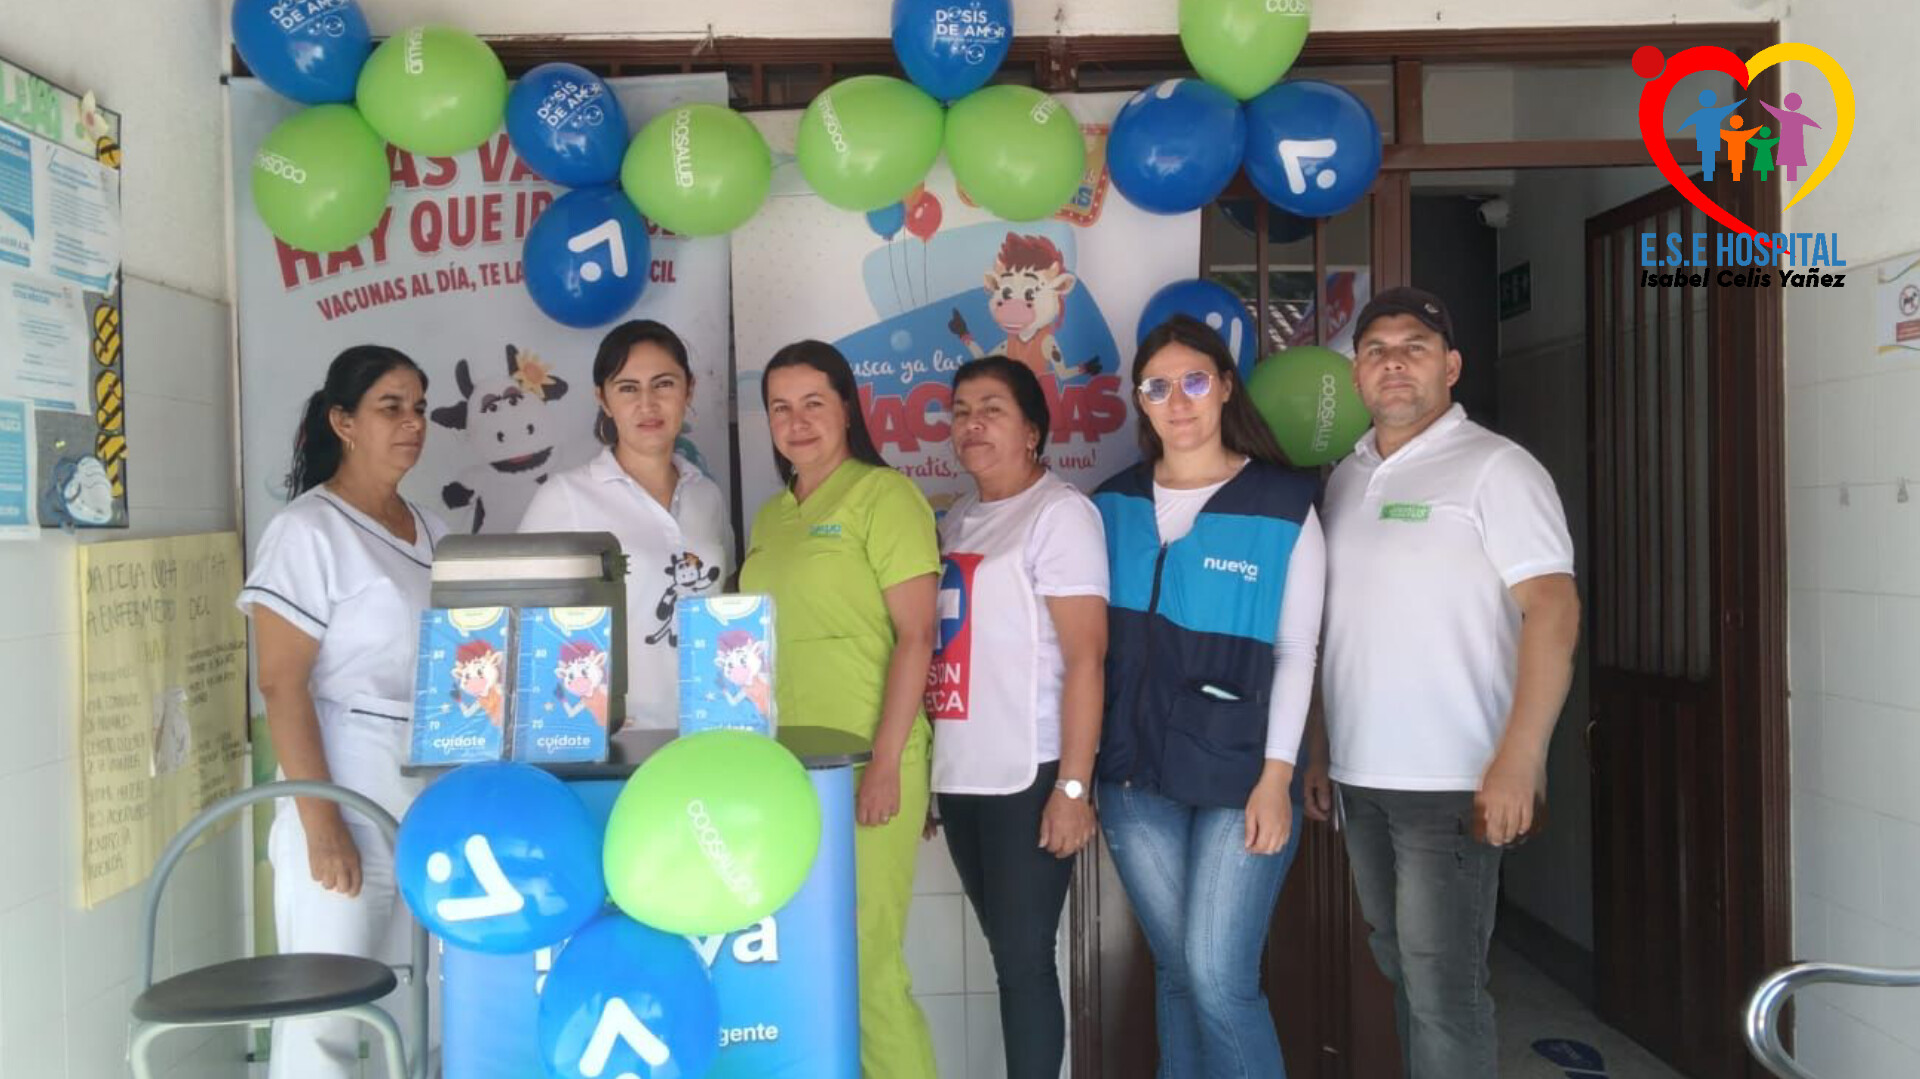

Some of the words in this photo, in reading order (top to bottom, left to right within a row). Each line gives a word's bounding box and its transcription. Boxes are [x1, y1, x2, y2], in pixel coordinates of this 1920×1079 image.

[936, 23, 960, 36] DE
[274, 206, 393, 289] HAY
[410, 193, 503, 254] QUE
[316, 277, 408, 321] VACUNAS
[411, 274, 435, 298] AL
[435, 262, 477, 293] DÍA,
[478, 262, 501, 287] TE
[850, 360, 896, 377] usca
[900, 359, 928, 384] ya
[1059, 447, 1097, 470] una!
[1203, 555, 1259, 577] nueva
